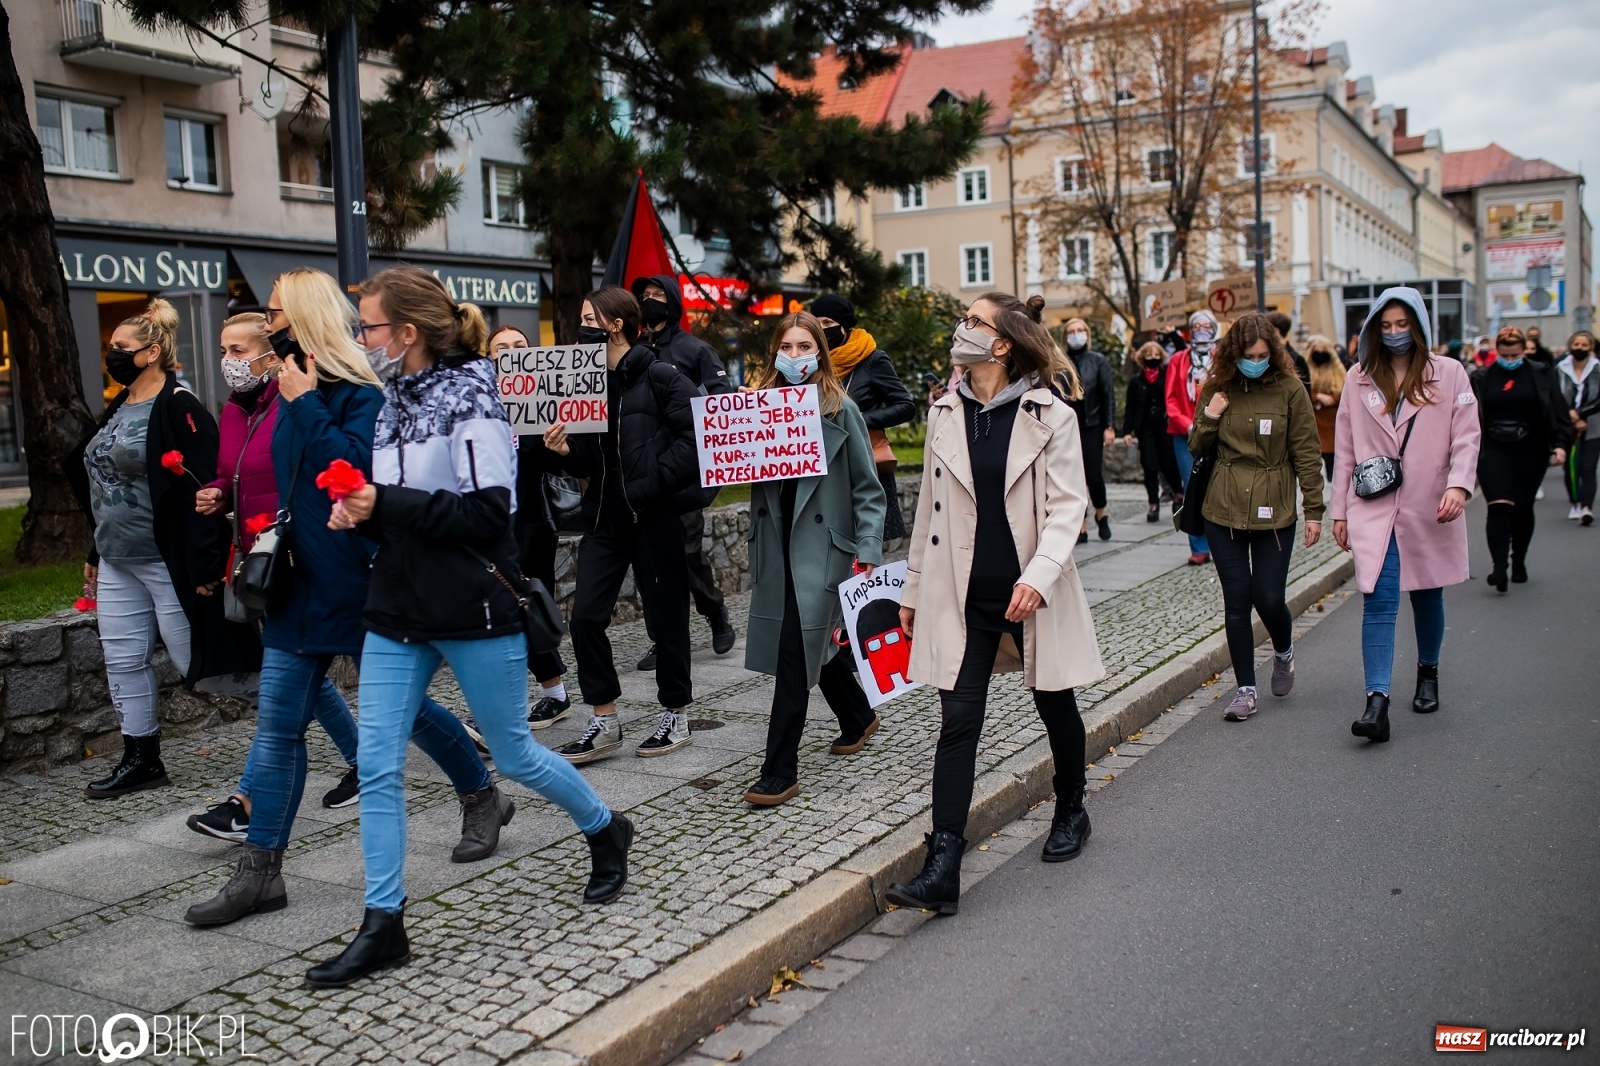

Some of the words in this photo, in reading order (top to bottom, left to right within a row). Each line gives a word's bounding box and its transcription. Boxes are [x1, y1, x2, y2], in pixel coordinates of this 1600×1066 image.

[155, 250, 225, 289] SNU
[499, 350, 567, 374] CHCESZ
[500, 374, 536, 396] GOD
[536, 373, 565, 397] ALE
[502, 399, 558, 426] TYLKO
[558, 399, 609, 423] GODEK
[705, 391, 770, 415] GODEK
[778, 387, 807, 404] TY
[703, 424, 776, 449] PRZESTAŃ
[787, 425, 806, 438] MI
[843, 569, 905, 611] Impostor
